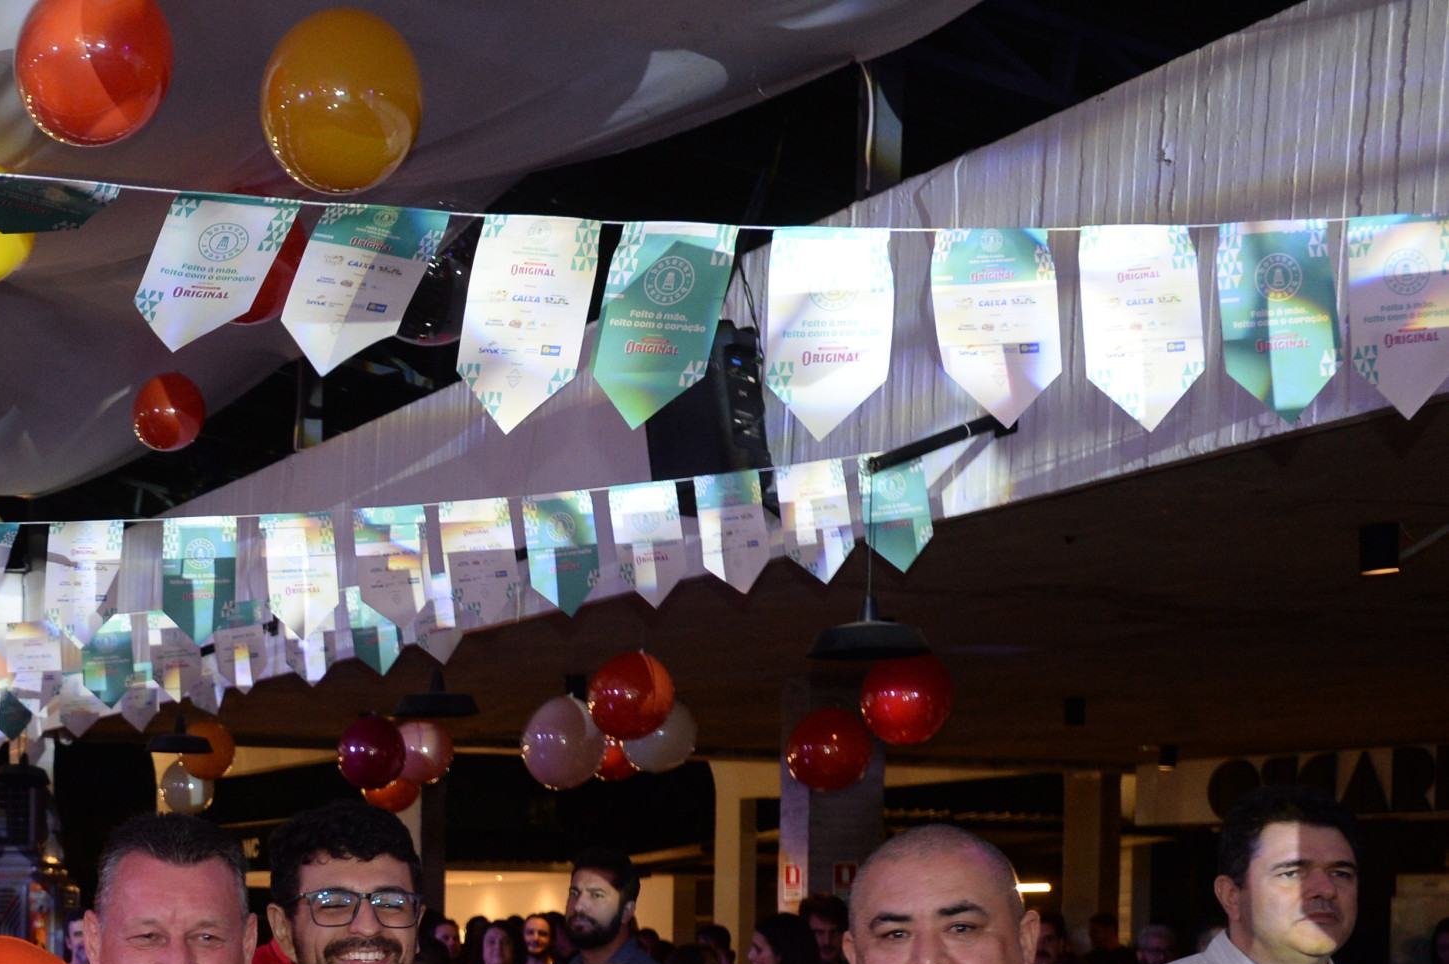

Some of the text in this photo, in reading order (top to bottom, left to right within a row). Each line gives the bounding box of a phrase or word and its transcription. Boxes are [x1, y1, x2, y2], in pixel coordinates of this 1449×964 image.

[511, 264, 556, 277] ORIGINAL
[1117, 271, 1161, 283] ORIGINAL
[172, 286, 230, 300] ORIGINAL
[512, 294, 540, 303] CAIXA
[630, 309, 654, 319] Feito
[610, 318, 633, 327] feito
[634, 321, 655, 329] com
[664, 321, 706, 333] coração
[1384, 332, 1439, 348] ORIGINAL
[802, 350, 860, 367] ORIGINAL
